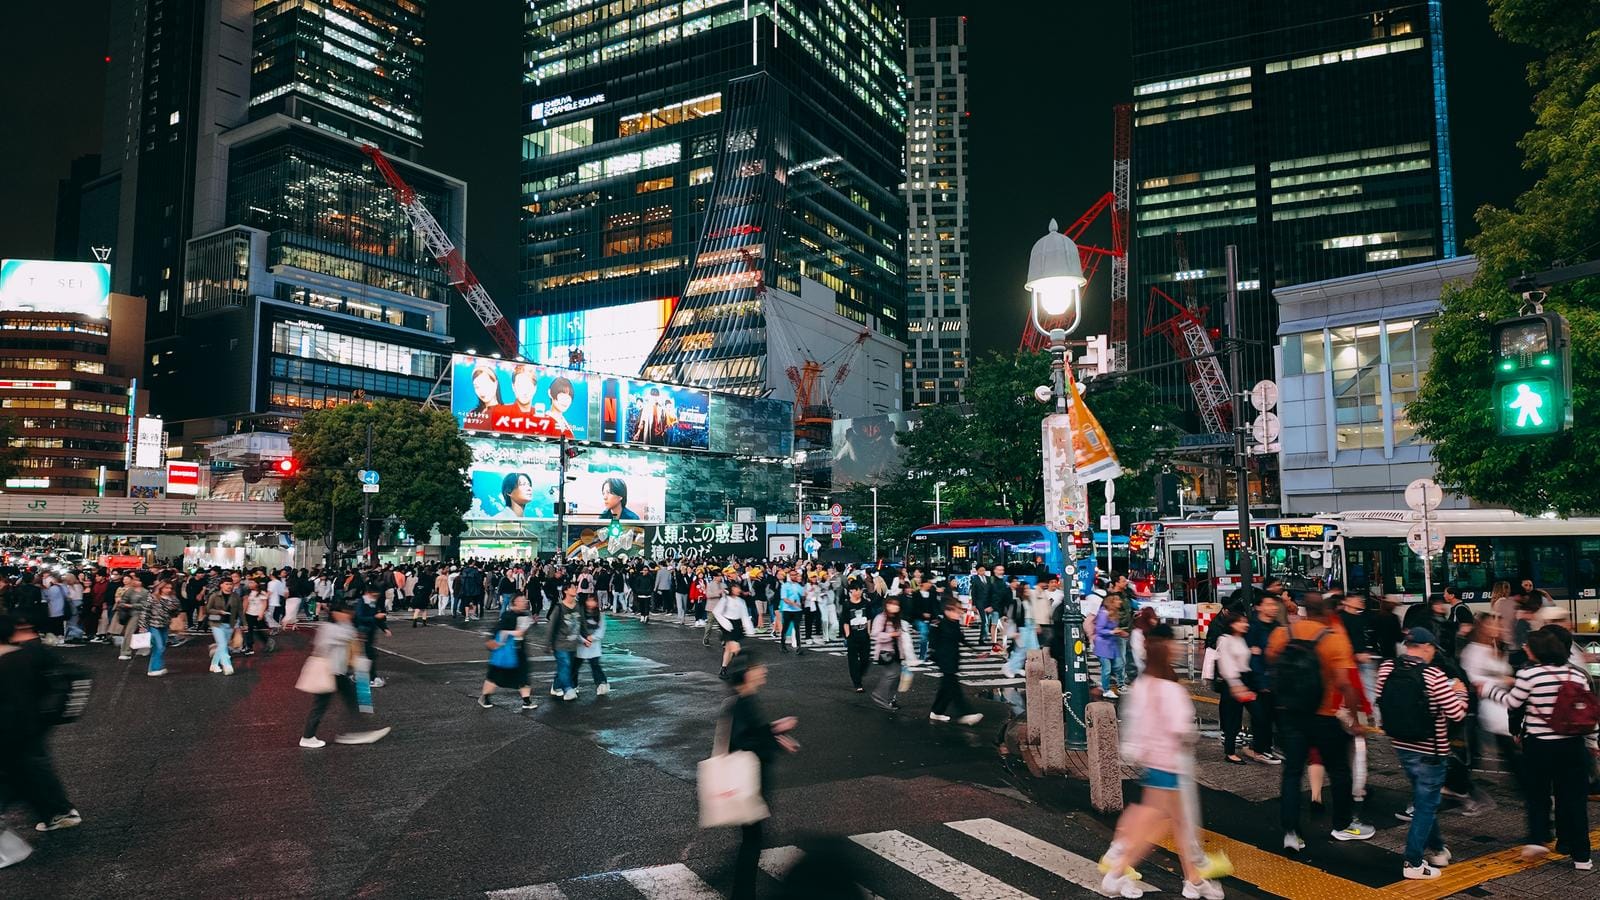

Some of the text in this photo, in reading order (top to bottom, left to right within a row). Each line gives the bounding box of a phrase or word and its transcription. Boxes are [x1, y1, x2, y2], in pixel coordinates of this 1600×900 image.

[544, 95, 572, 108] SHIBUYA
[544, 94, 605, 117] SCRAMBLE SQUARE
[495, 415, 550, 431] ペイトク
[27, 499, 47, 510] JR
[81, 499, 198, 516] 渋谷駅
[651, 523, 759, 544] 人類よ、この惑星は
